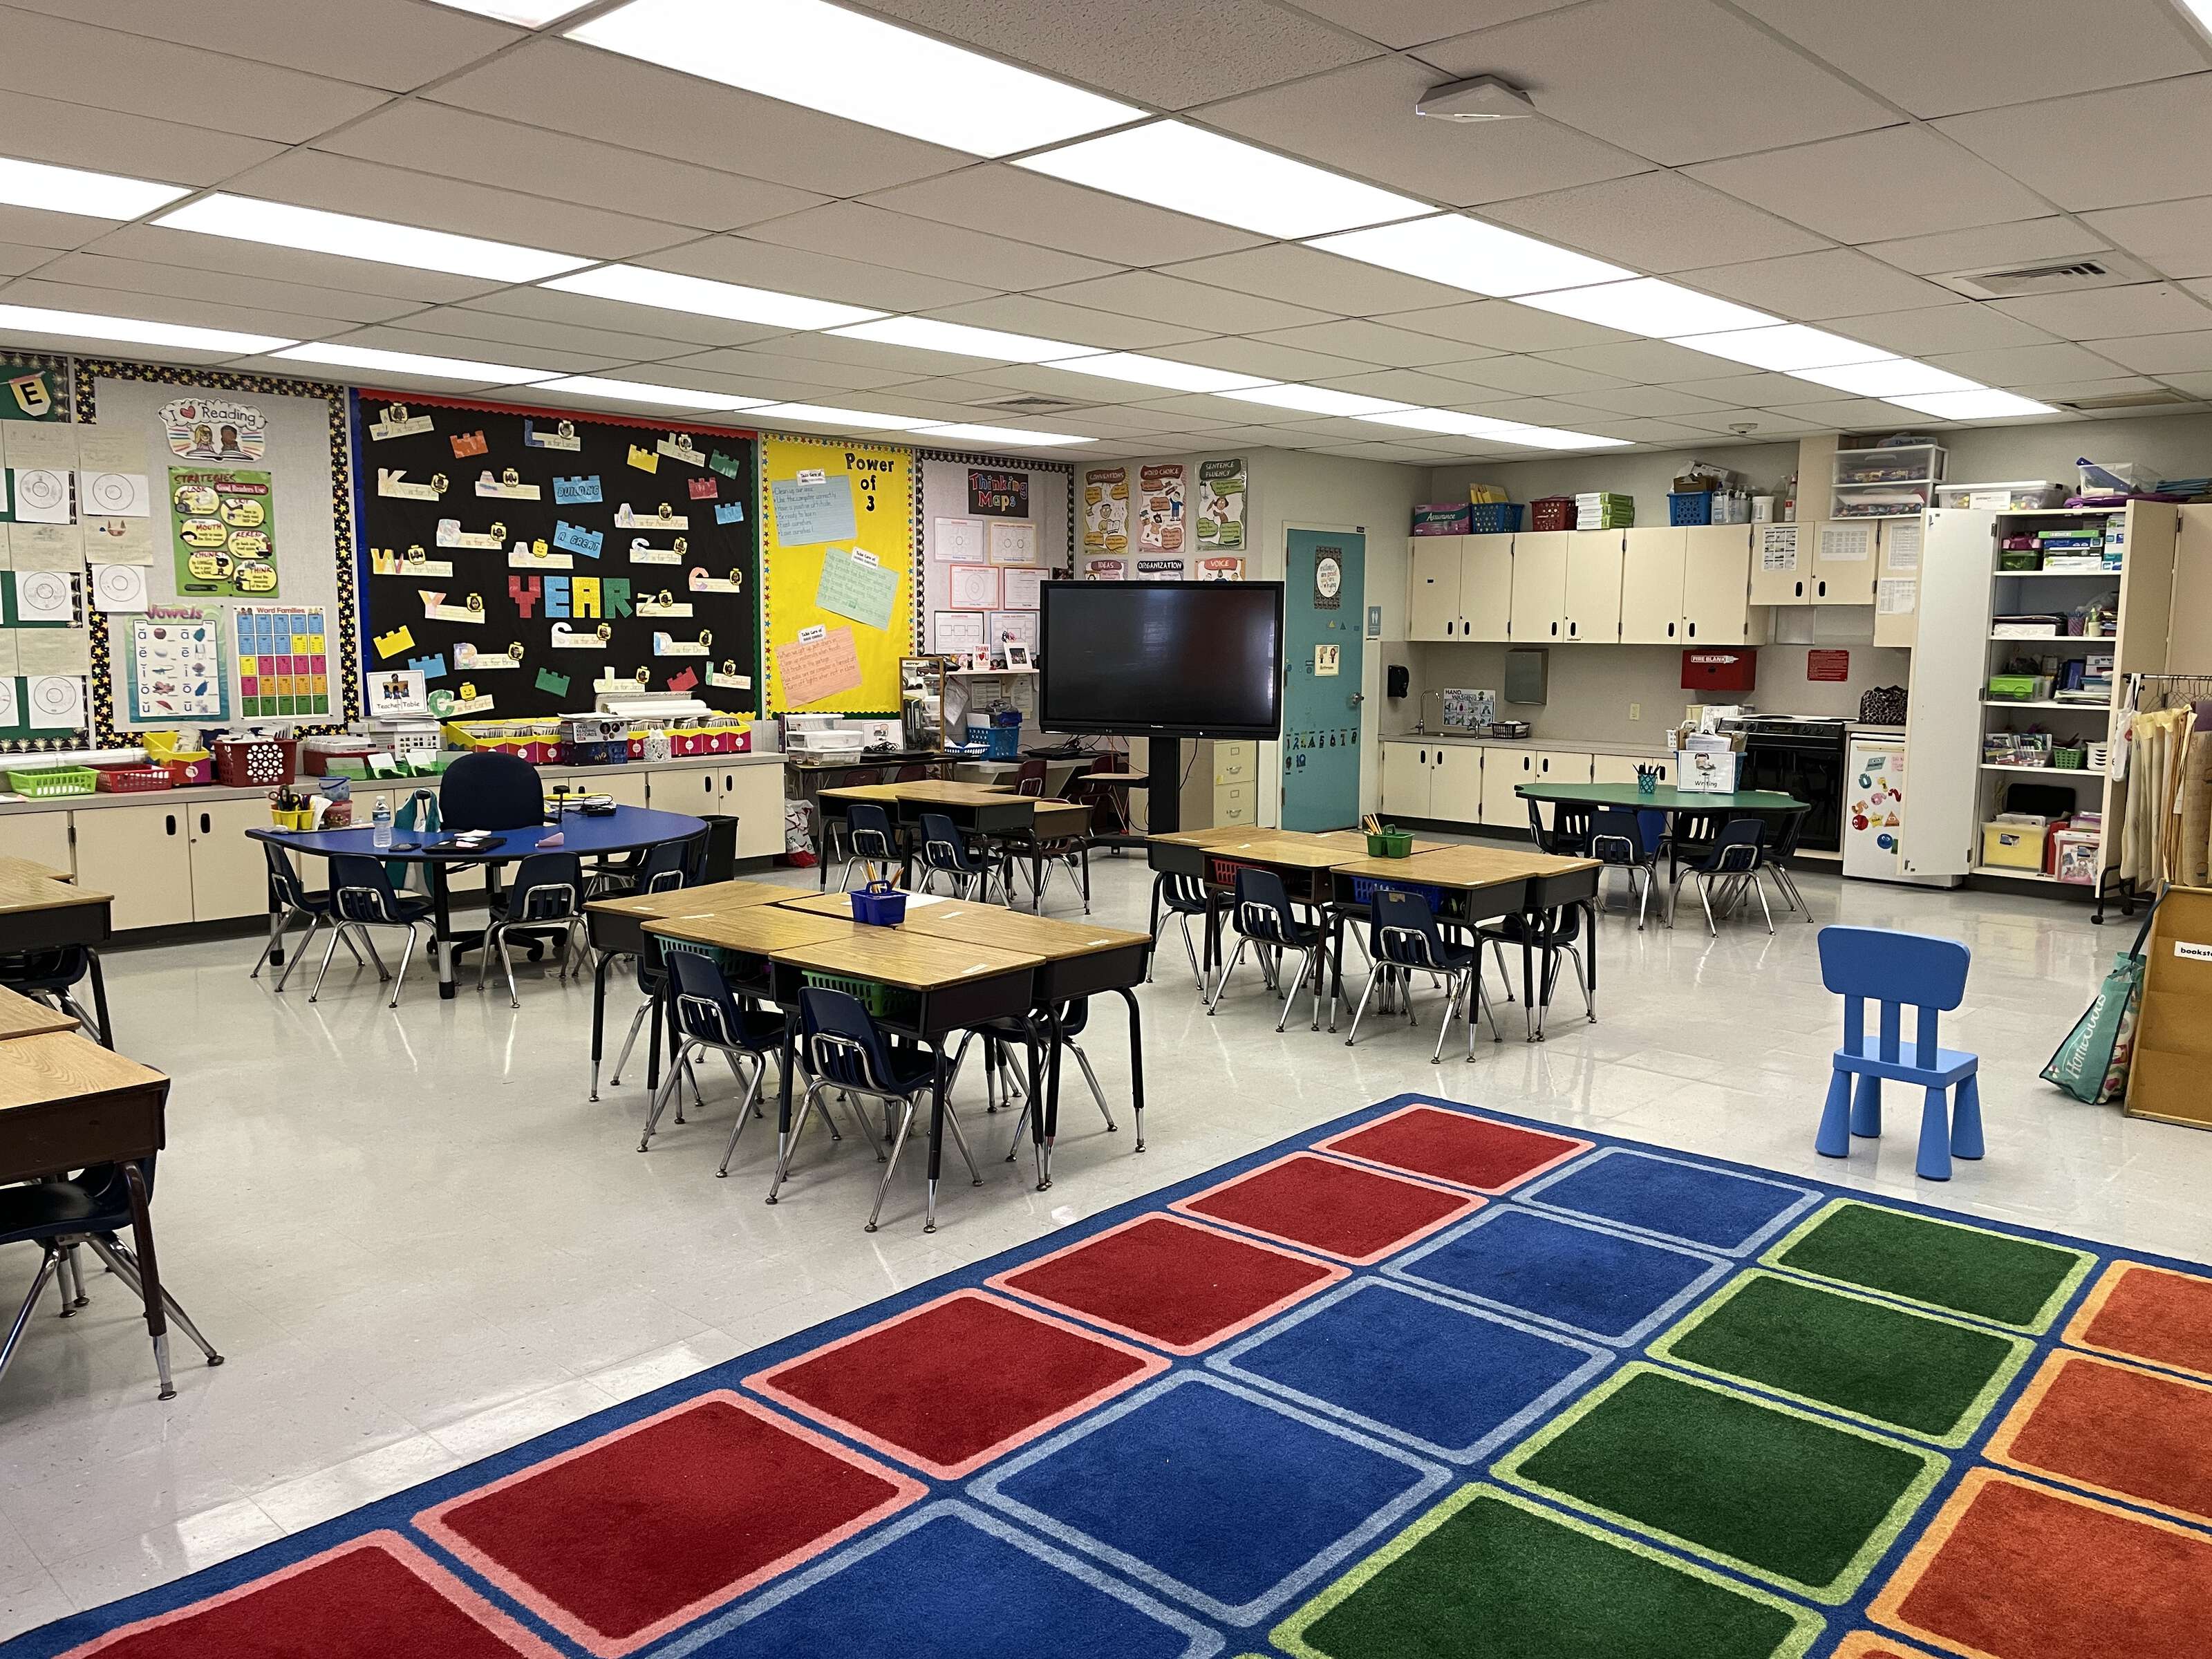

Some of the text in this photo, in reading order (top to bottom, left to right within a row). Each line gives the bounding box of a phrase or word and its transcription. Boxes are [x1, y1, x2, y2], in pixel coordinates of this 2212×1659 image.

[19, 382, 43, 406] E
[170, 406, 256, 426] I Reading
[845, 453, 894, 472] Power
[1206, 462, 1235, 470] SENTENCE
[1089, 471, 1124, 481] CONVENTIONS
[1160, 467, 1179, 476] CHOICE
[861, 475, 877, 490] of
[969, 473, 1028, 500] Thinking
[866, 496, 875, 512] 3
[979, 491, 1016, 512] Maps
[1427, 512, 1456, 521] Assurance
[559, 532, 599, 551] A GREAT
[1138, 561, 1182, 570] ORGANIZATION
[509, 575, 633, 619] YEAR
[147, 606, 203, 619] Vowels
[1293, 737, 1300, 750] 2
[1329, 734, 1336, 747] 6
